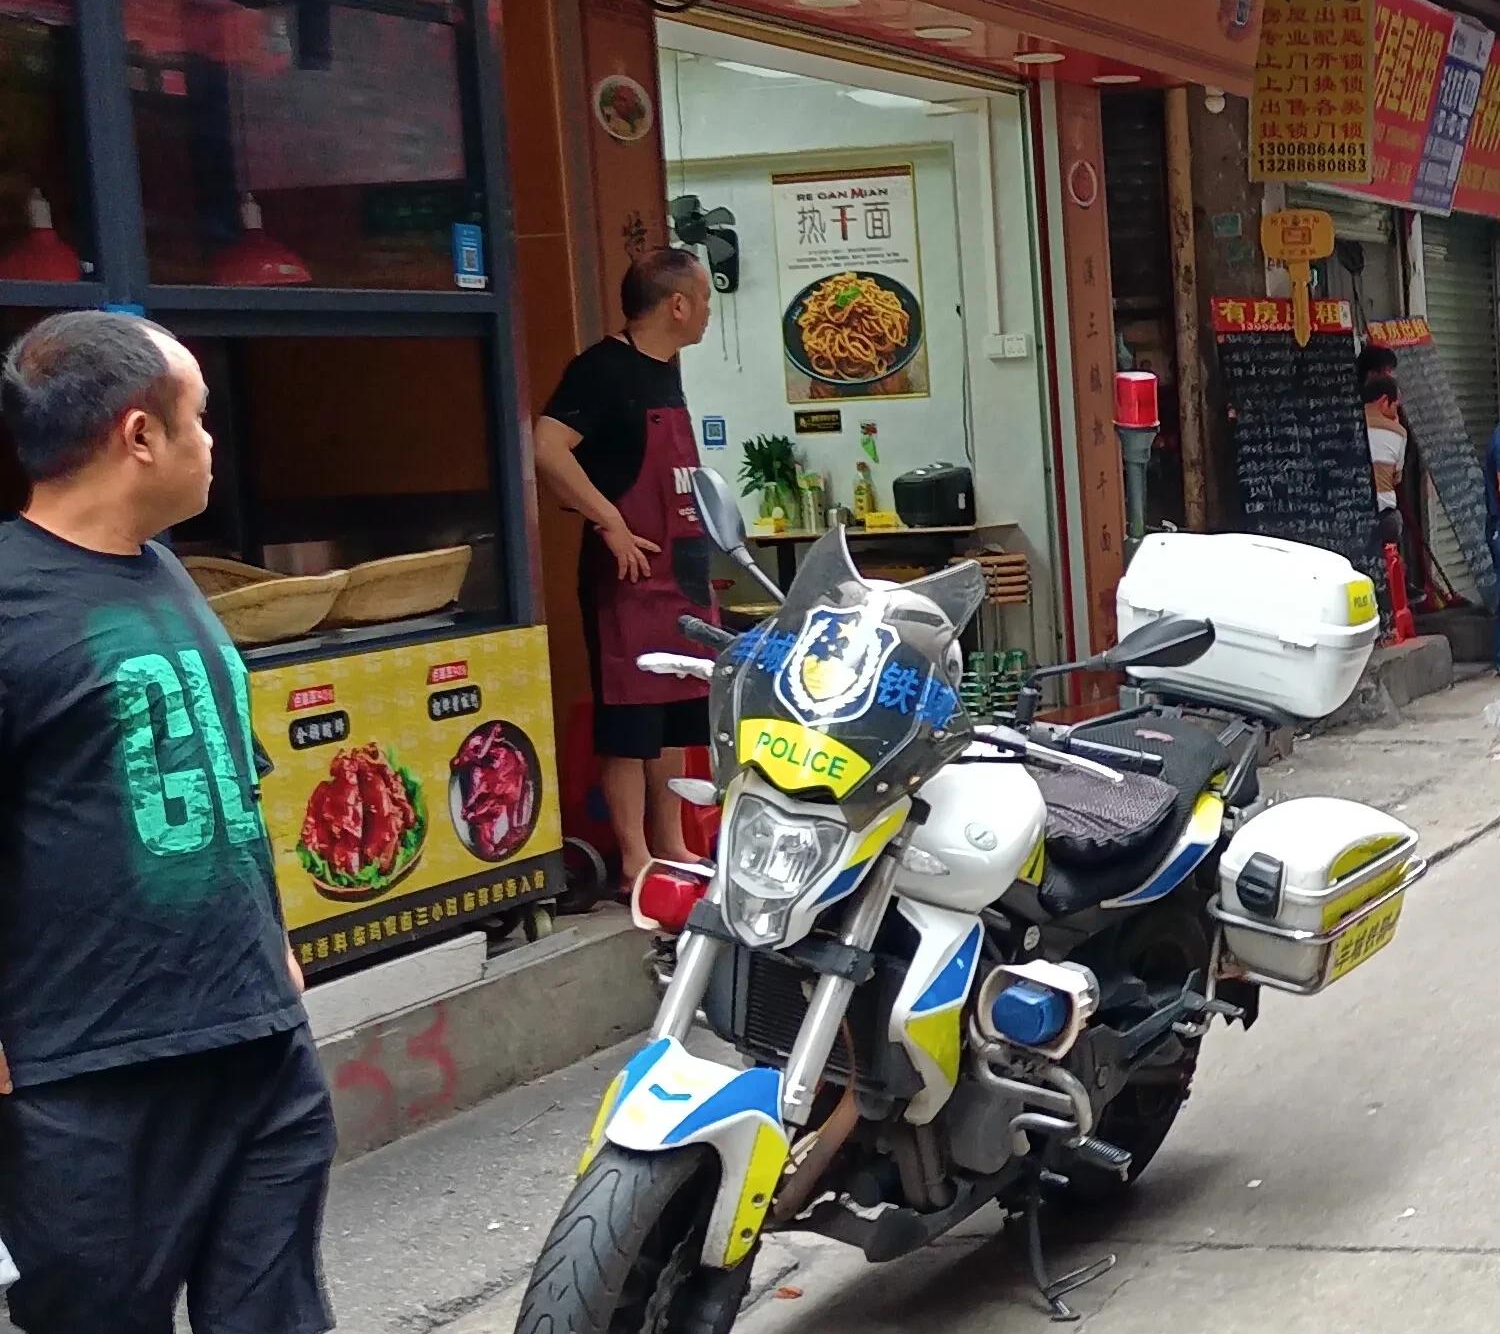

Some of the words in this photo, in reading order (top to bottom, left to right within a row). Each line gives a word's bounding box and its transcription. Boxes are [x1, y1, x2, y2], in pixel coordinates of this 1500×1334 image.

[797, 202, 891, 245] 热干面
[1218, 300, 1343, 324] 有房租
[756, 731, 849, 779] POLICE
